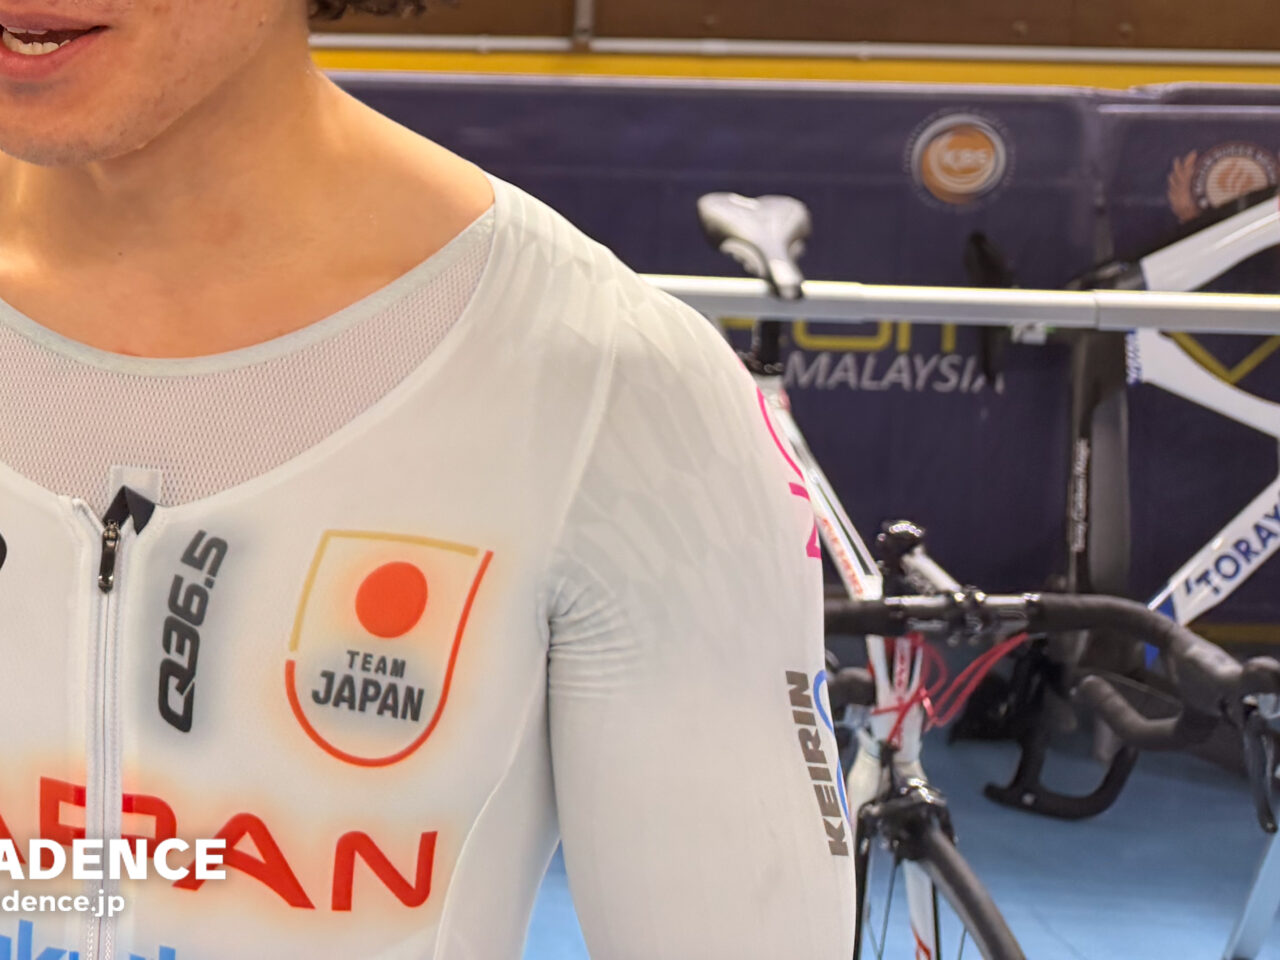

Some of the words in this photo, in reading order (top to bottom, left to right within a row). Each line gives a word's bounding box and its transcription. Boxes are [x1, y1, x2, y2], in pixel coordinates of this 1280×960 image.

[158, 529, 229, 733] Q36.5
[346, 649, 406, 679] TEAM
[311, 669, 425, 722] JAPAN
[785, 670, 850, 856] KEIRIN
